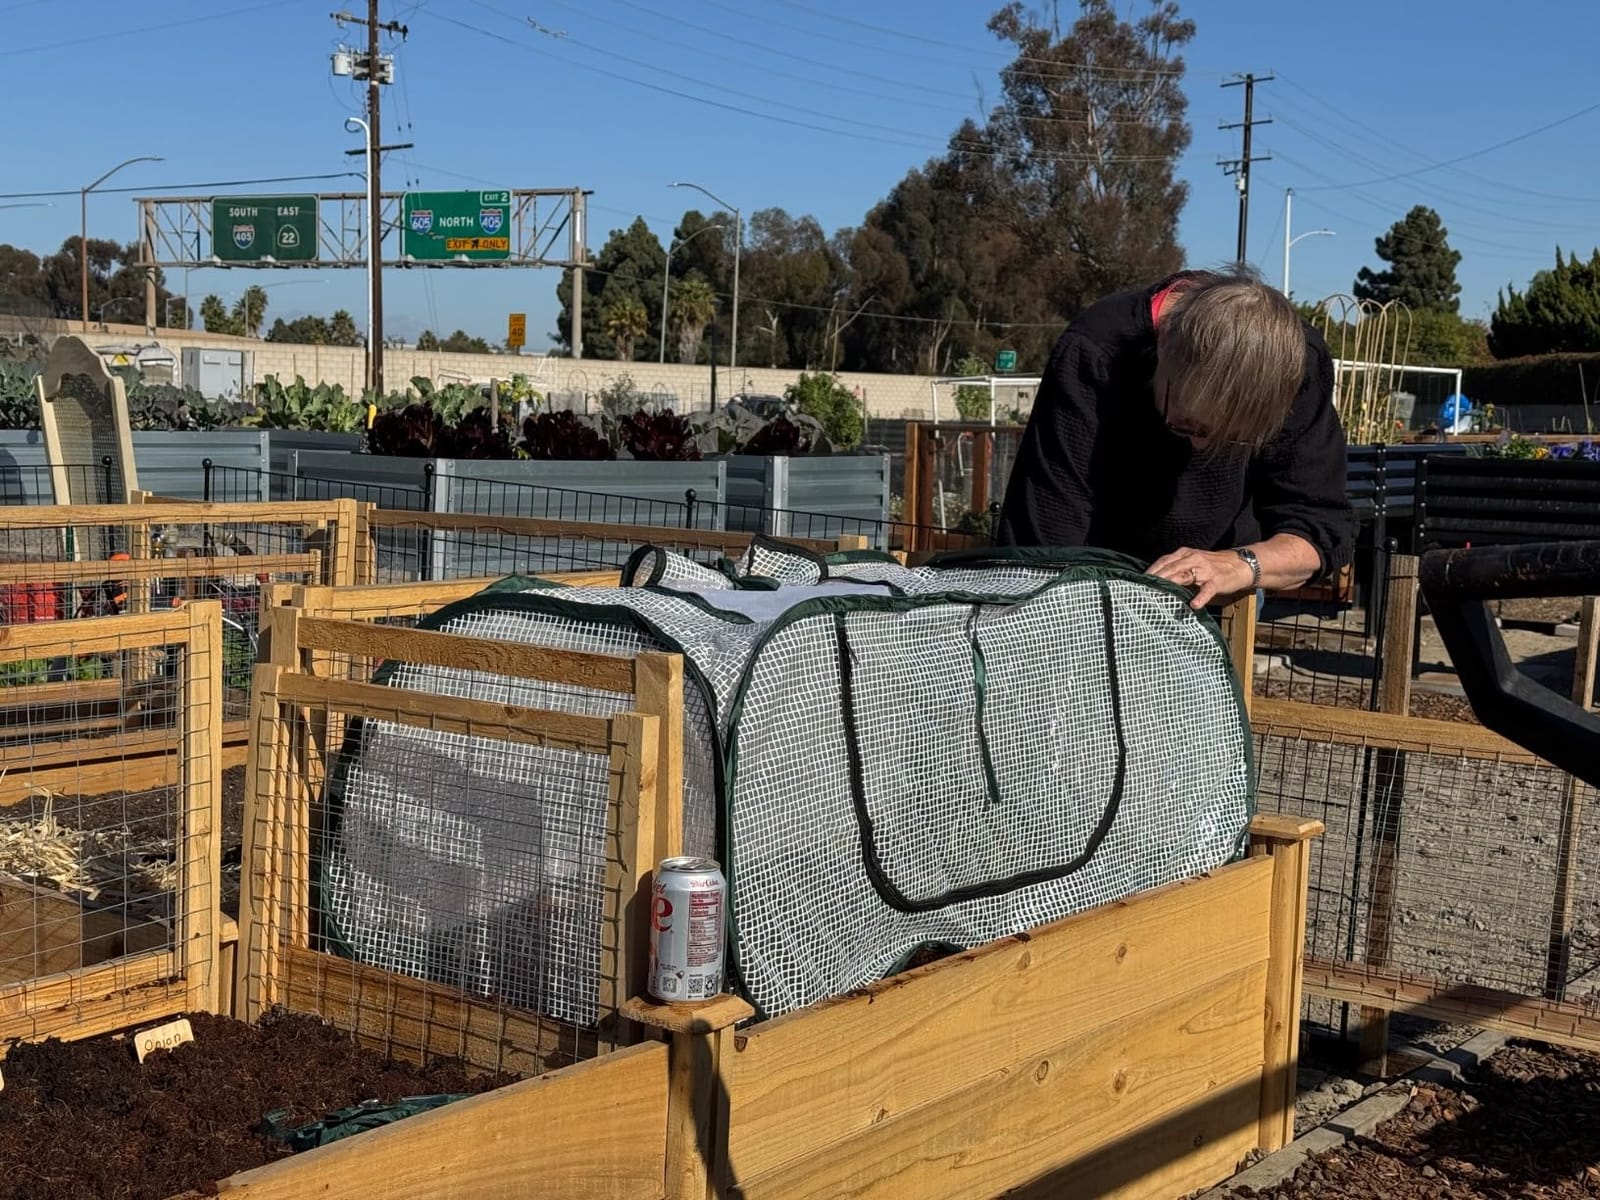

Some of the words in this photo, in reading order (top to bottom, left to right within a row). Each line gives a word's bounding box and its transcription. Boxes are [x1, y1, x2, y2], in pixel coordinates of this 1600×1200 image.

[501, 192, 508, 202] 2
[228, 207, 258, 217] SOUTH
[277, 206, 299, 216] EAST
[413, 217, 431, 229] 605
[439, 216, 474, 227] NORTH
[482, 217, 500, 228] 405
[235, 232, 252, 241] 405
[281, 232, 295, 243] 22
[447, 240, 466, 249] EXIT
[482, 240, 507, 249] ONLY
[511, 328, 523, 337] 40
[144, 1033, 182, 1051] Onion
